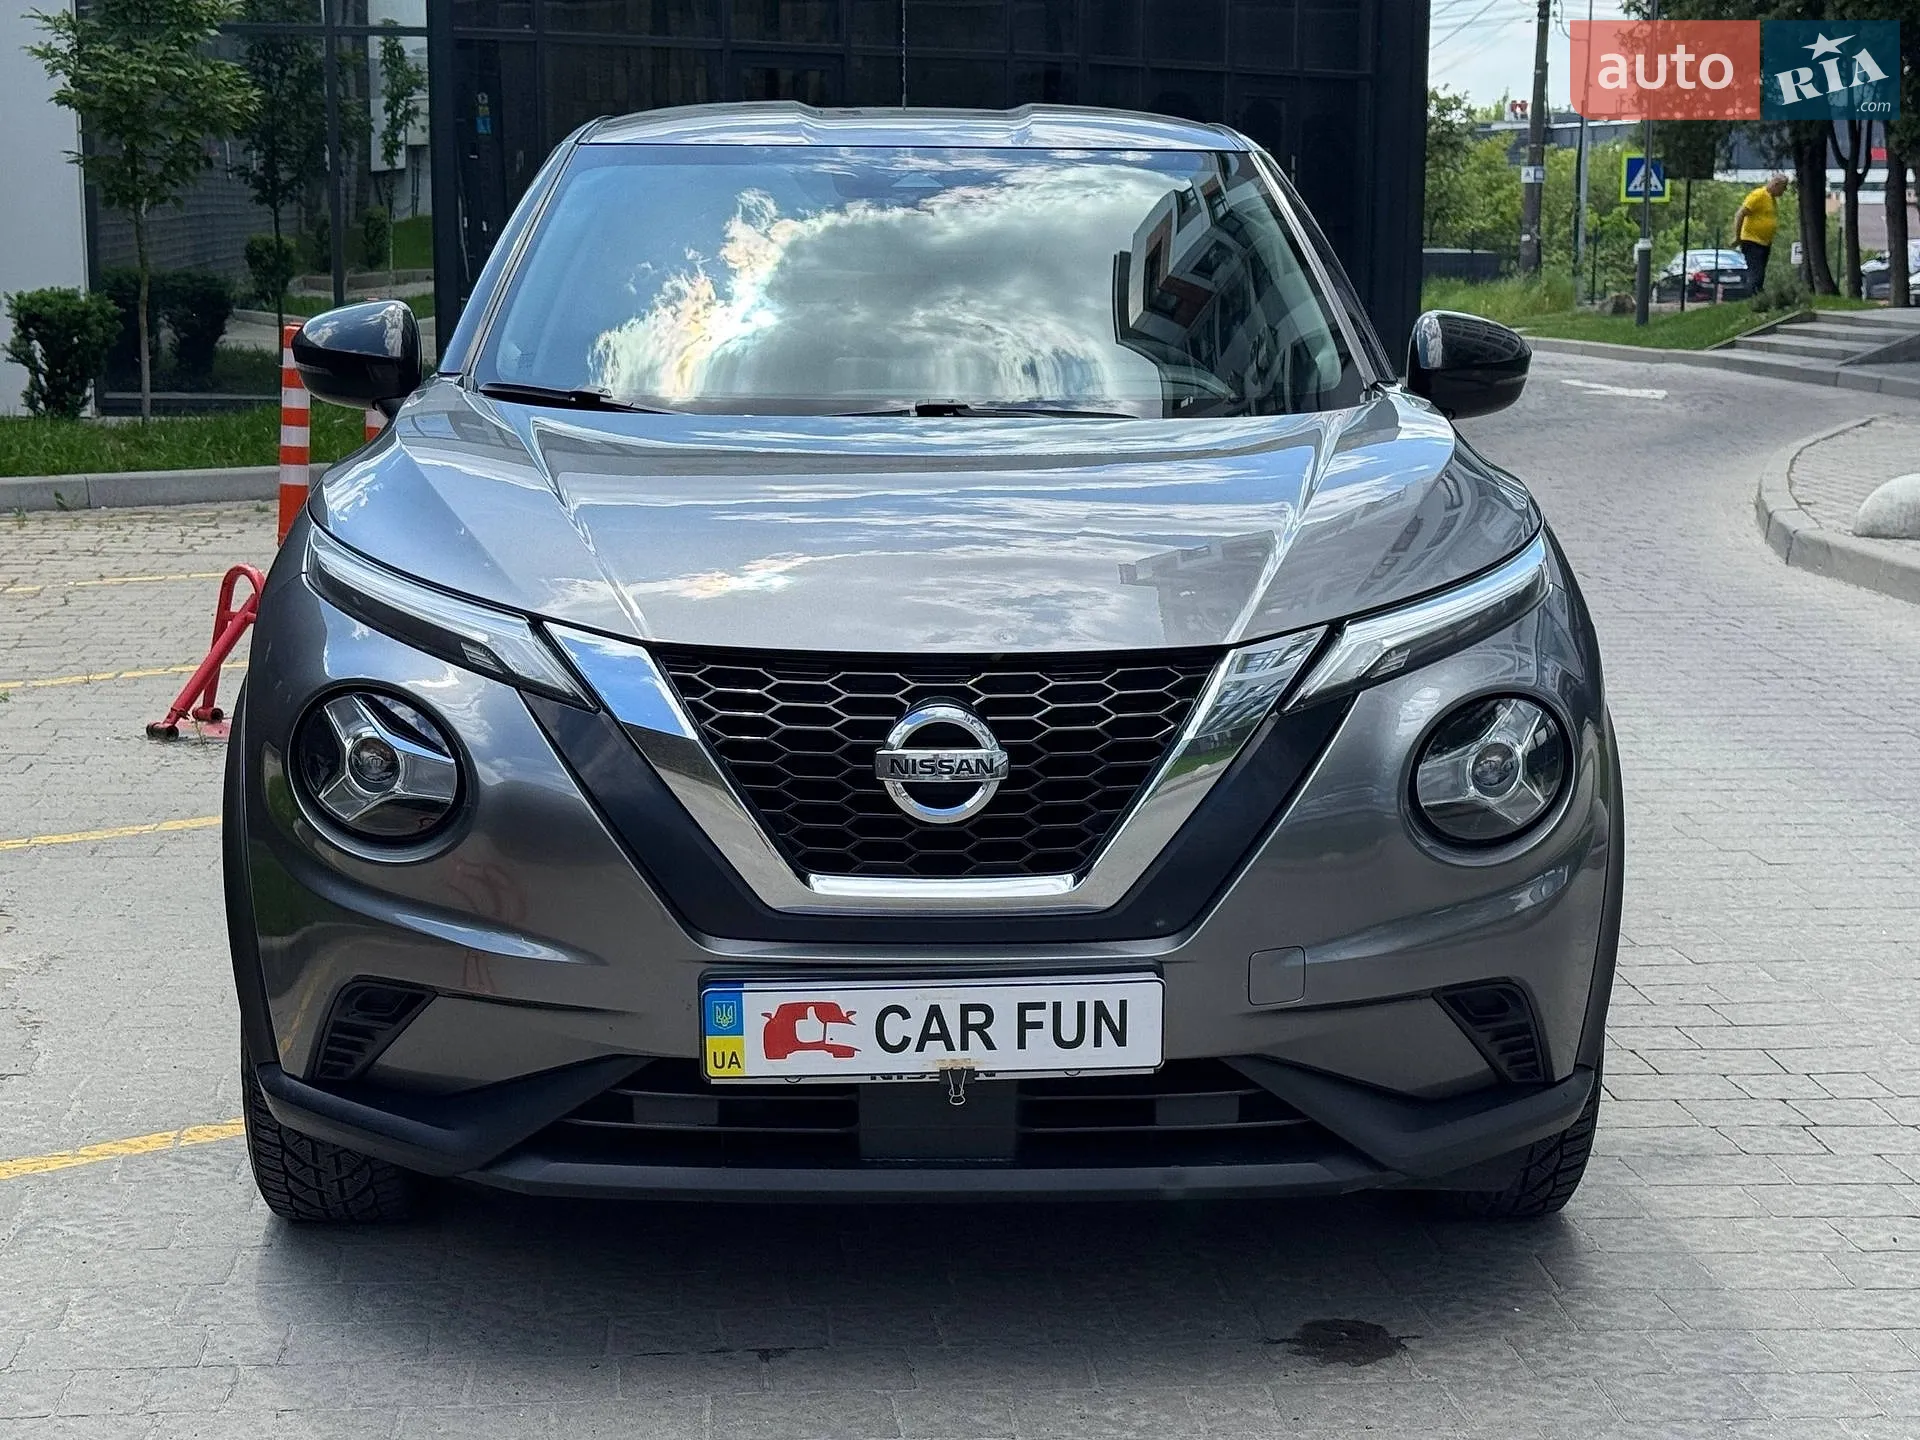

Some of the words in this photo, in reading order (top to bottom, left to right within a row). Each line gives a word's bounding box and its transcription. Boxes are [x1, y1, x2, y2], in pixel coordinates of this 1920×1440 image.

[889, 757, 994, 775] NISSAN
[875, 1003, 998, 1054] CAR
[1017, 999, 1127, 1050] FUN
[713, 1050, 742, 1069] UA
